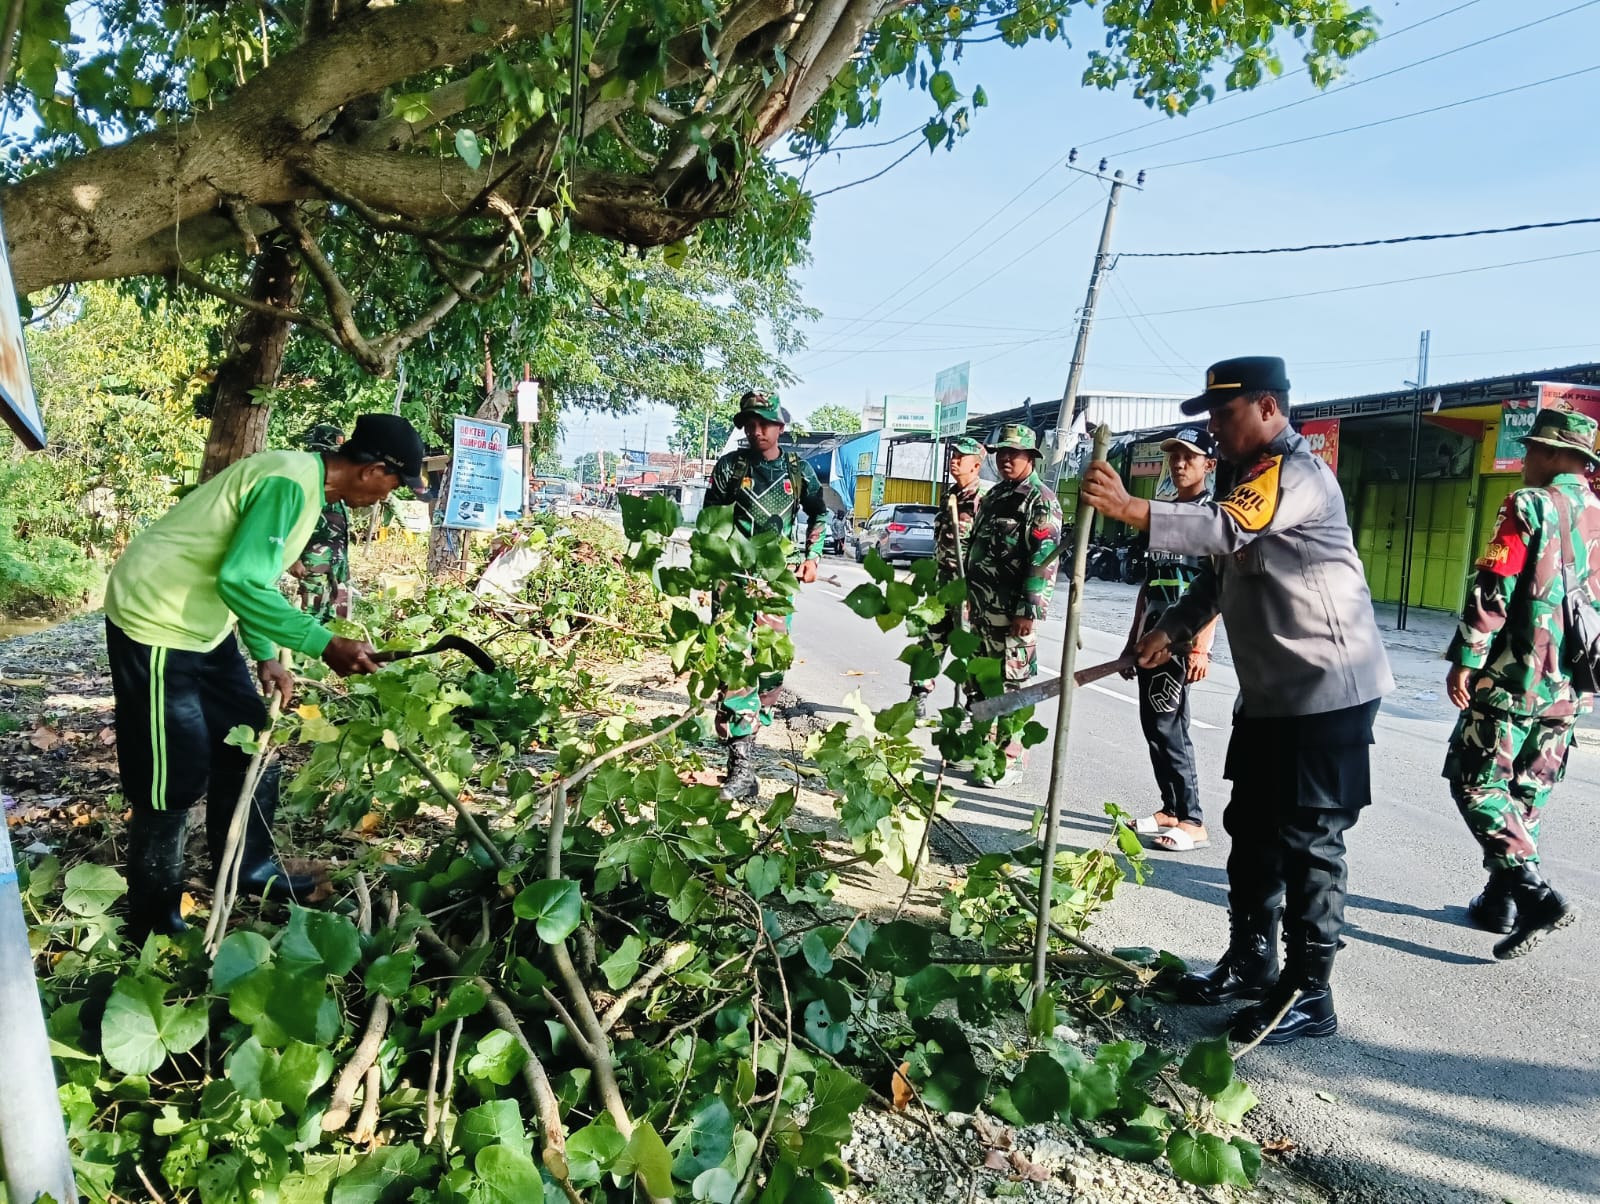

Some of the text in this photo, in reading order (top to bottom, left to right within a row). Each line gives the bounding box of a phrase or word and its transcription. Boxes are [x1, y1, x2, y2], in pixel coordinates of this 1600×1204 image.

[460, 425, 486, 437] DOKTER
[460, 437, 503, 452] KOMPOR GAS
